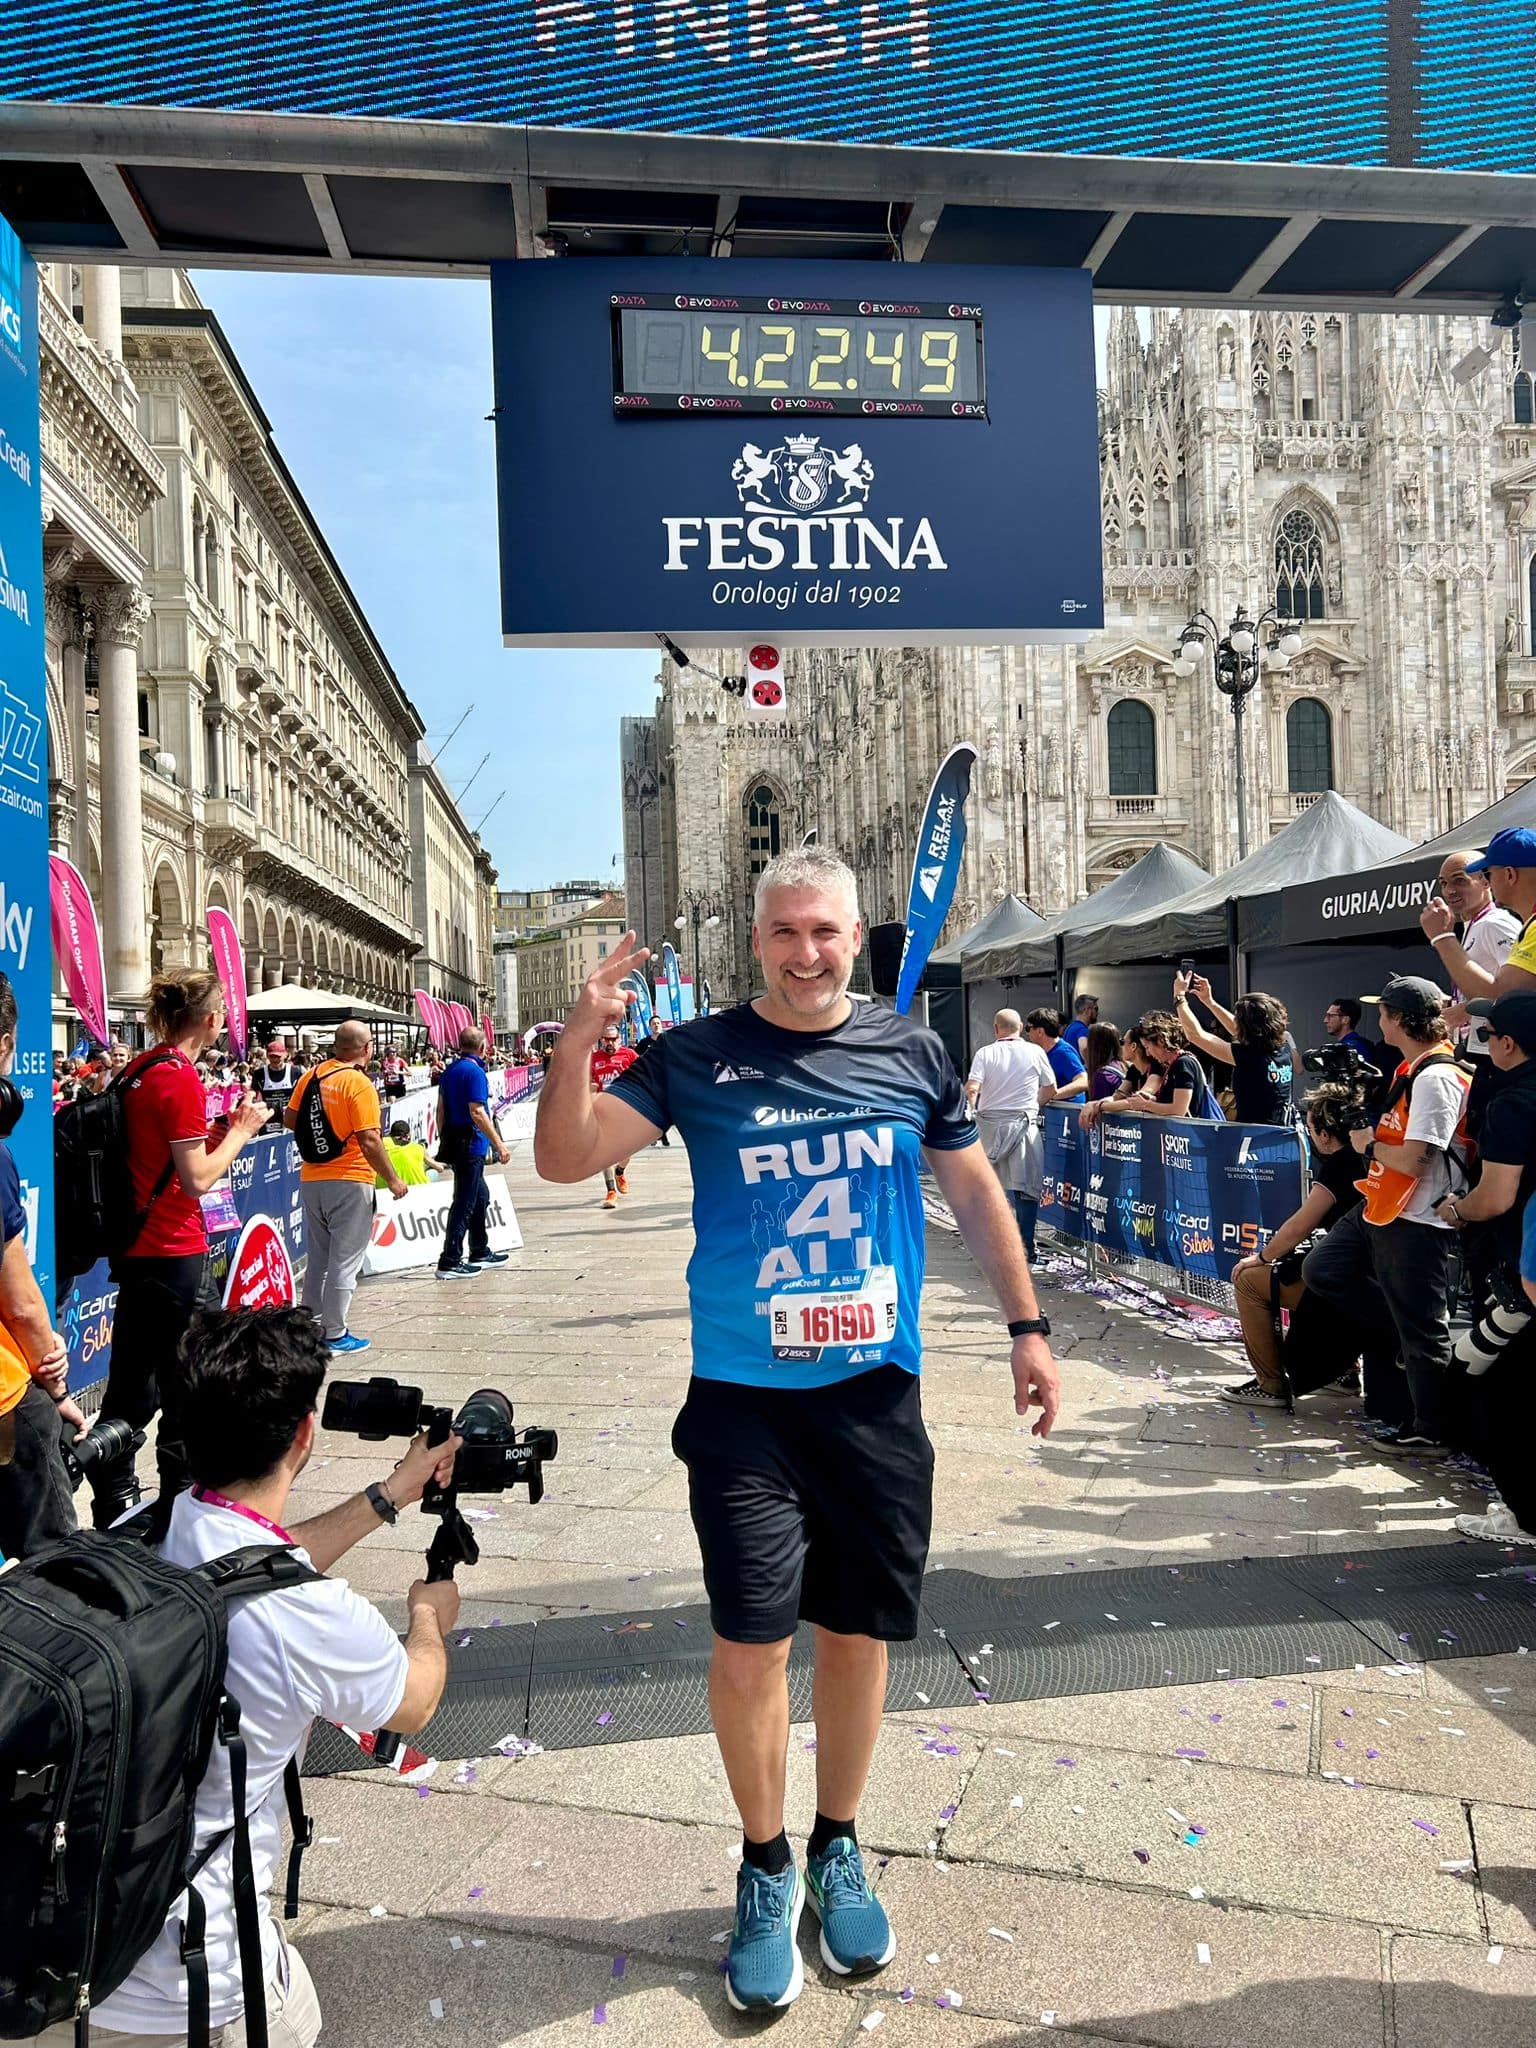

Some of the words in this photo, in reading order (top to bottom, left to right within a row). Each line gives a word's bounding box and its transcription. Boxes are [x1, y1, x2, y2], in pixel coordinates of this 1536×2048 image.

[689, 297, 739, 308] EVODATA
[782, 300, 831, 311] EVODATA
[873, 304, 920, 314] EVODATA
[693, 398, 742, 408] EVODATA
[786, 399, 834, 410] EVODATA
[876, 402, 924, 412] EVODATA
[661, 516, 949, 571] FESTINA
[711, 580, 799, 611] Orologi
[805, 578, 841, 605] dal
[848, 585, 901, 609] 1902
[928, 792, 950, 859] RELAY
[938, 797, 956, 862] MARATHON
[1321, 879, 1438, 920] GIURIA/JURY
[14, 1051, 47, 1075] LSEE
[738, 1127, 894, 1185] RUN
[1117, 1140, 1137, 1155] Sport
[1165, 1134, 1190, 1155] SPORT
[785, 1176, 863, 1241] 4
[1222, 1222, 1277, 1249] PIST
[505, 1446, 533, 1460] RONIN
